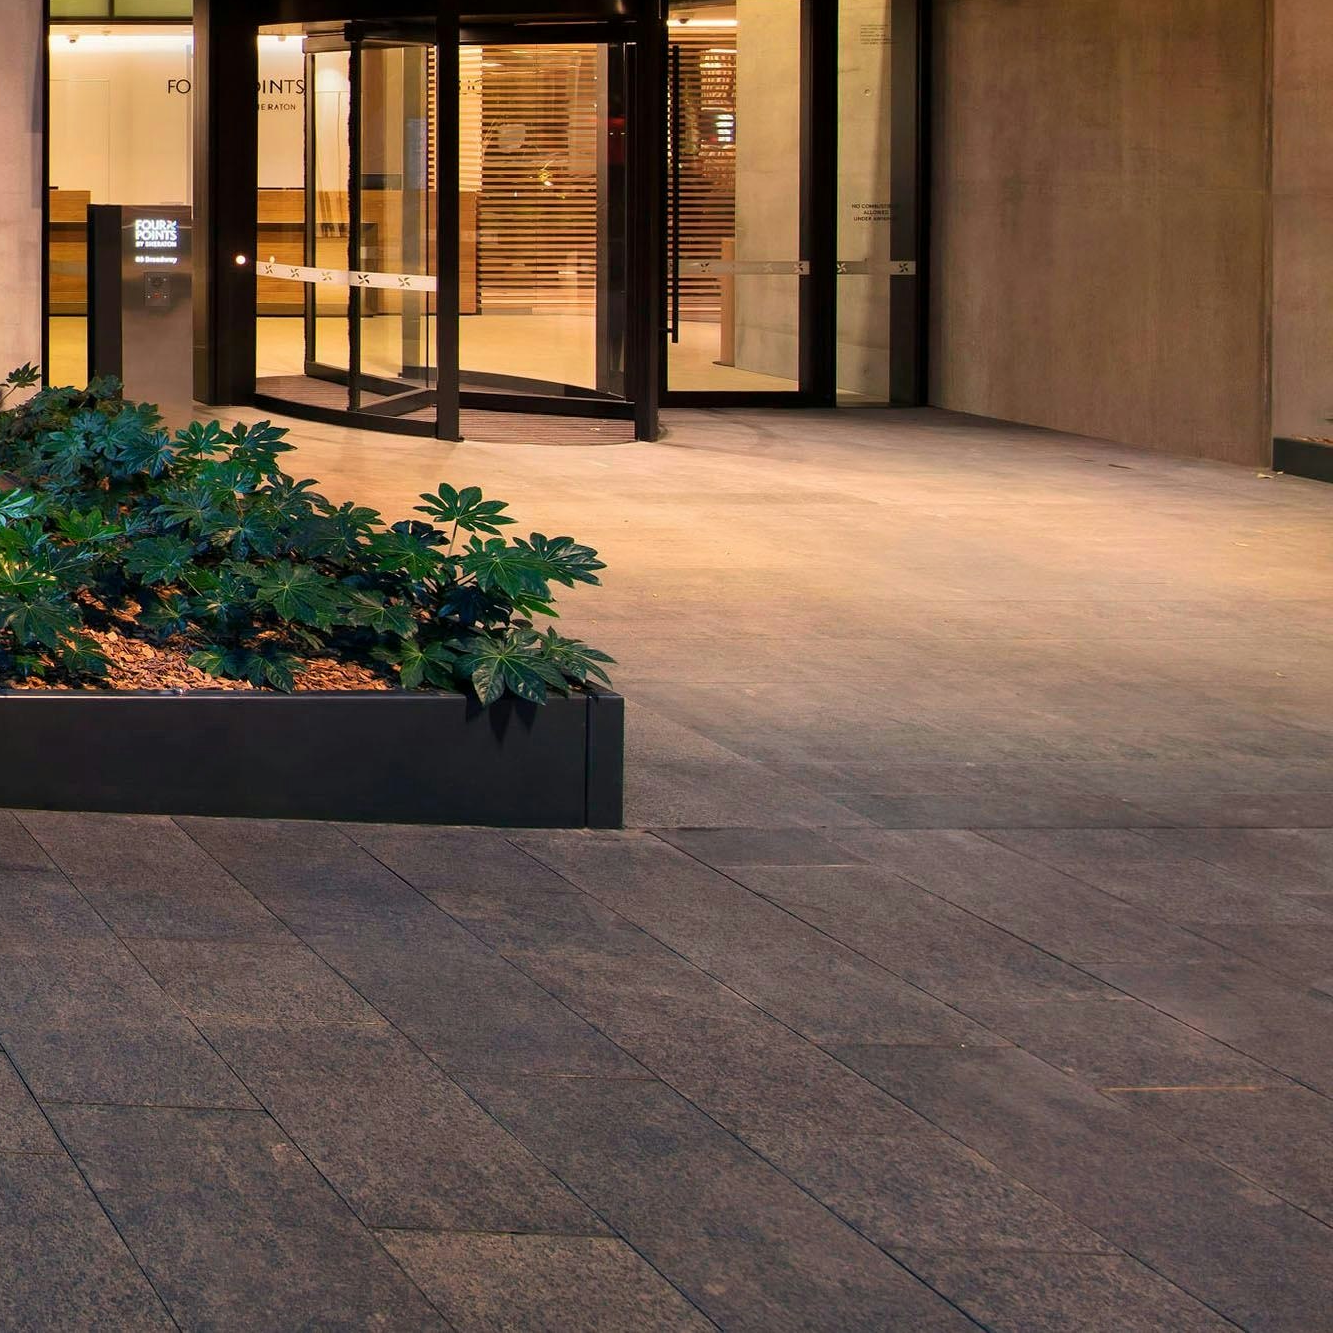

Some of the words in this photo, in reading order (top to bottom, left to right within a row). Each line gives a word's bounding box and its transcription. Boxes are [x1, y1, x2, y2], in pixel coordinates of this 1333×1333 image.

[167, 79, 192, 94] FO
[257, 79, 305, 95] INTS
[135, 219, 166, 230] FOUR
[135, 230, 178, 241] POINTS
